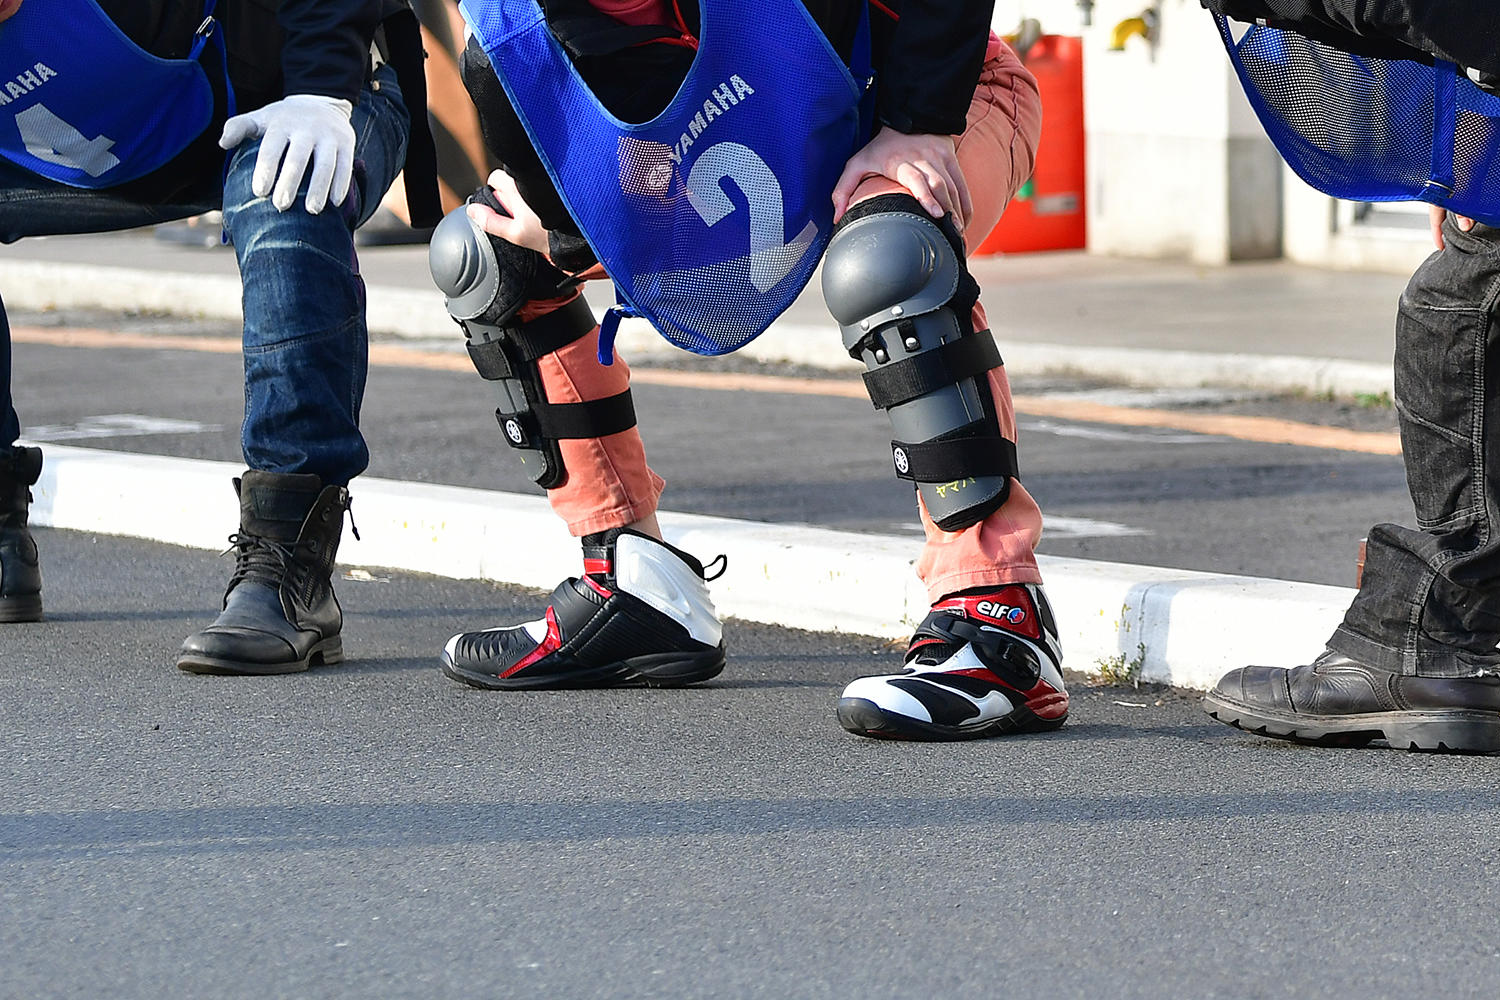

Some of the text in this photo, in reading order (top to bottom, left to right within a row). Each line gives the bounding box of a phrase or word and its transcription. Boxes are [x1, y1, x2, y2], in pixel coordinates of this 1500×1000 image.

[15, 102, 121, 178] 4
[669, 74, 756, 166] YAMAHA
[686, 141, 819, 294] 2
[976, 600, 1009, 619] elf
